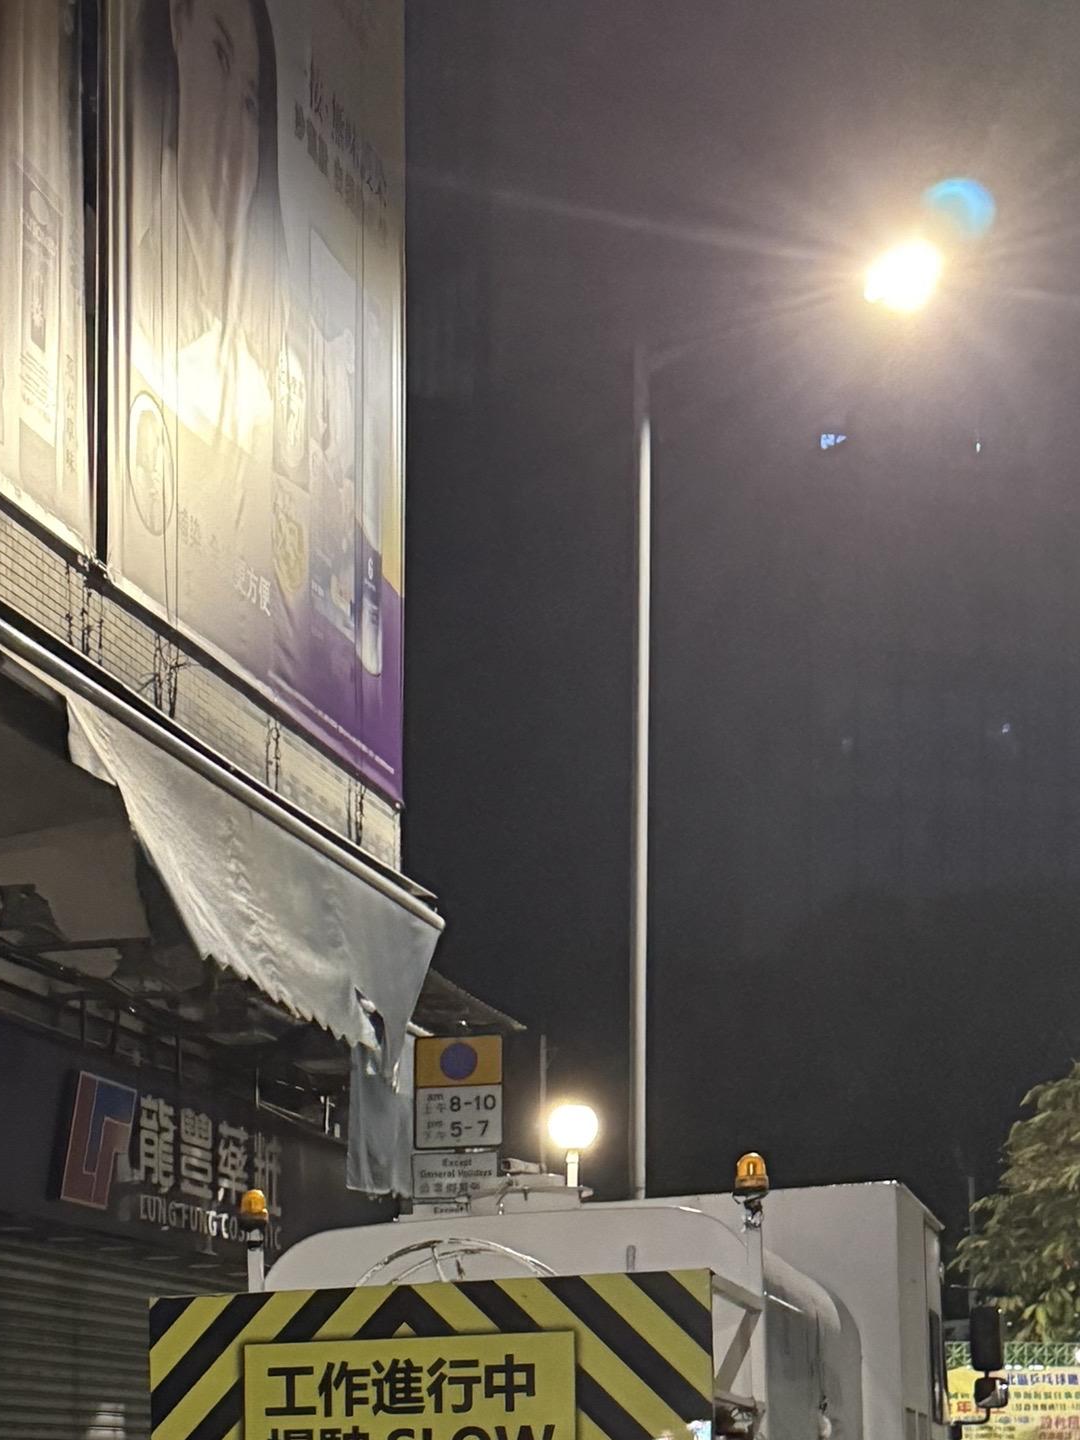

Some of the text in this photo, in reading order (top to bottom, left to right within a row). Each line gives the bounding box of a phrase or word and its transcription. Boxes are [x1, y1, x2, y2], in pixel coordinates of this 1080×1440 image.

[449, 1093, 496, 1113] 8-10
[442, 1158, 472, 1169] Except
[419, 1169, 455, 1179] General
[139, 1194, 178, 1228] LUNG
[180, 1201, 218, 1237] FUNG
[265, 1353, 536, 1418] 工作進行中
